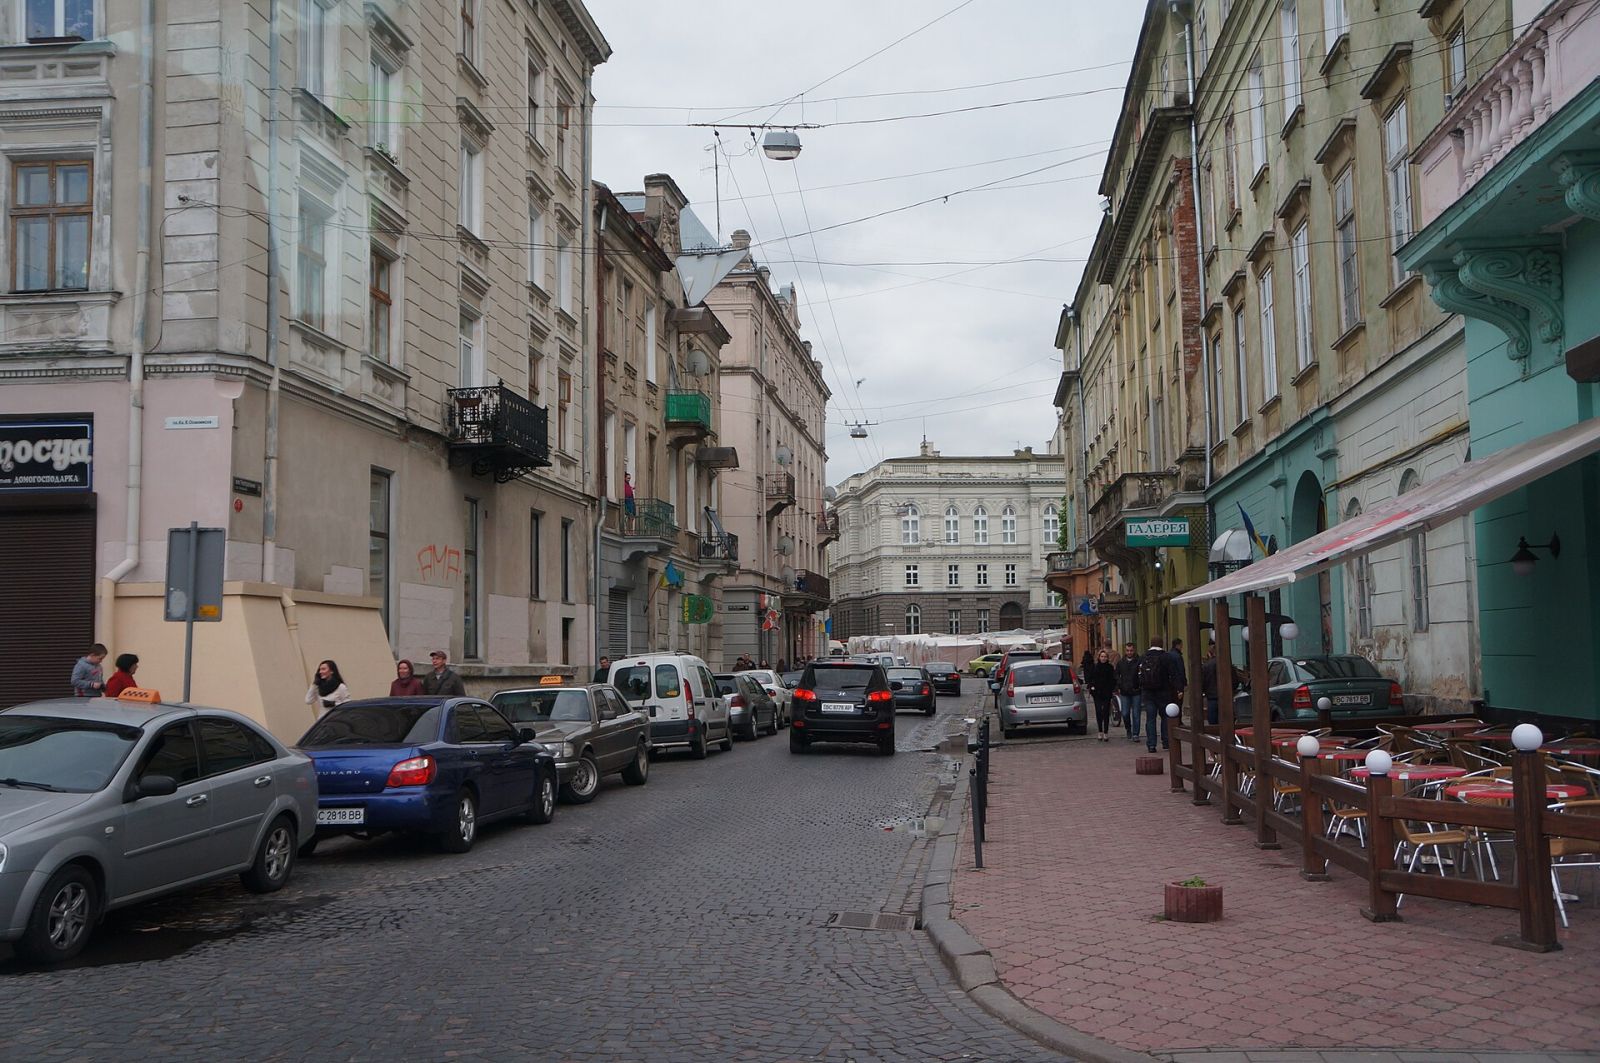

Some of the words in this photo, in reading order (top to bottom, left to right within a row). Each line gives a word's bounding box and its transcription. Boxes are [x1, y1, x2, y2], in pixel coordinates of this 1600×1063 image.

[14, 475, 79, 483] ДОМОГОСПОДАРКА
[1129, 524, 1186, 533] ГАЛЕРЕЯ
[327, 811, 347, 820] 2818
[349, 811, 361, 820] BB
